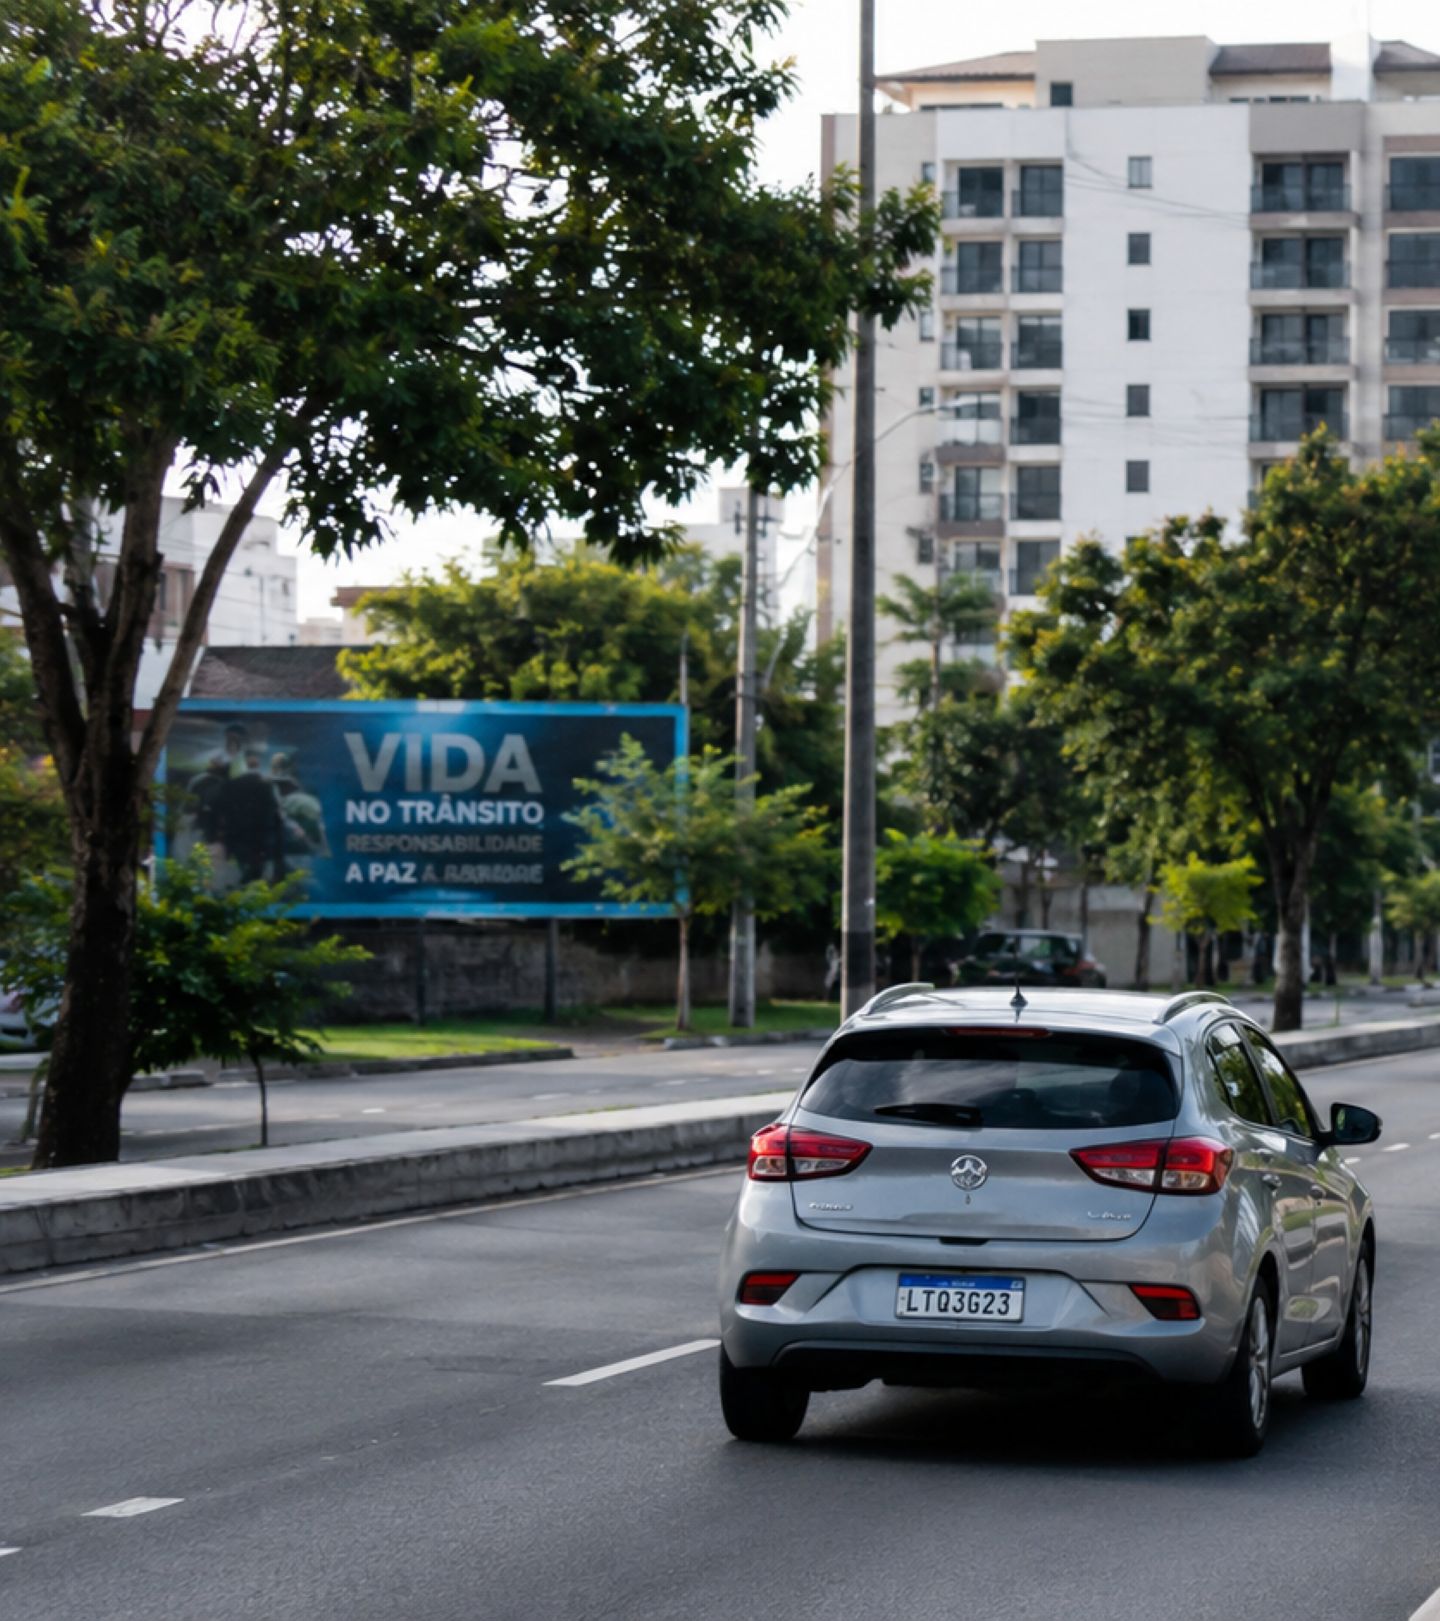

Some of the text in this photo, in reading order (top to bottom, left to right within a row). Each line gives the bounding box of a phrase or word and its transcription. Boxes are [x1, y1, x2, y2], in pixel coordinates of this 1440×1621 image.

[344, 732, 543, 793] VIDA
[345, 794, 544, 824] NO TRÂNSITO
[346, 834, 543, 853] RESPONSABILIDADE
[345, 863, 363, 883] A
[369, 862, 416, 883] PAZ
[906, 1289, 1011, 1316] LTQ3G23
